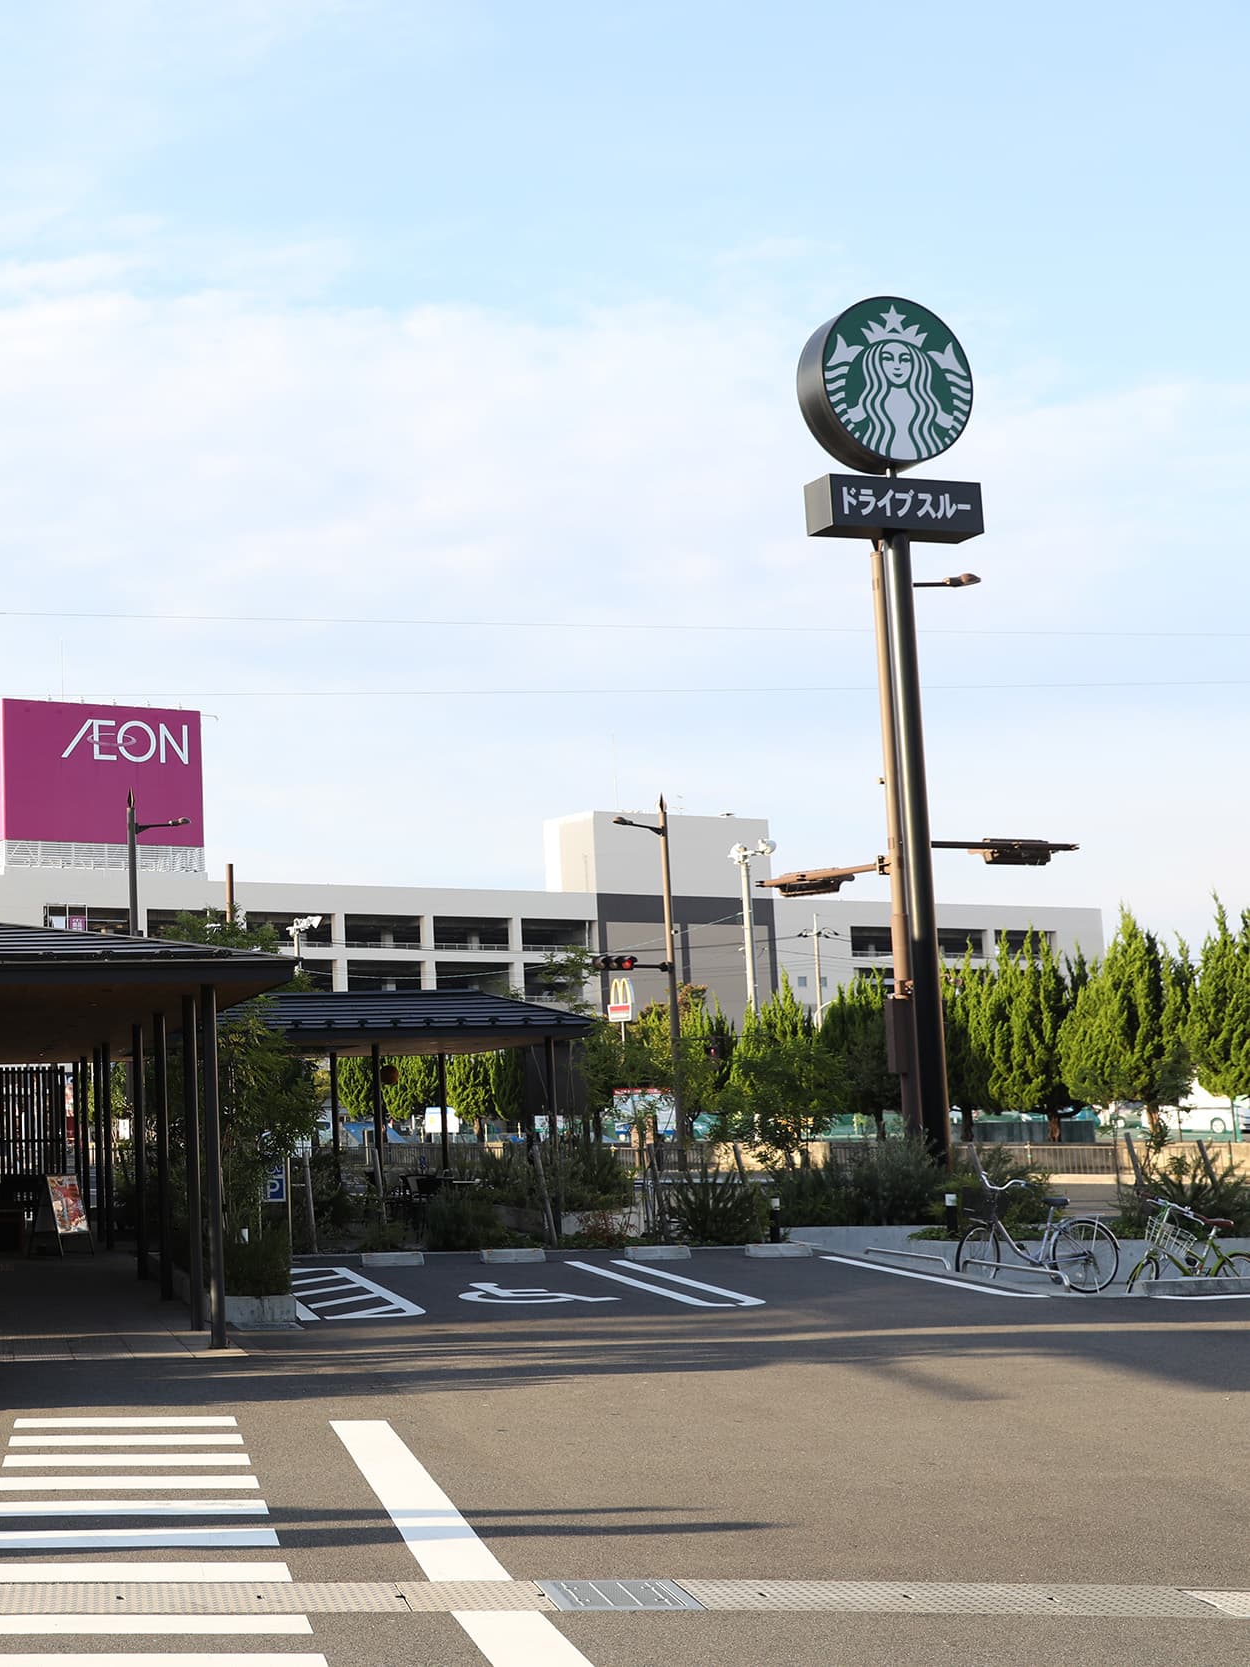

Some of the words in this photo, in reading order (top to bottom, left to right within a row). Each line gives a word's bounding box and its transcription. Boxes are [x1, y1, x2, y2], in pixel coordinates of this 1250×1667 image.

[841, 486, 972, 519] ドライブスルー
[266, 1179, 280, 1198] P
